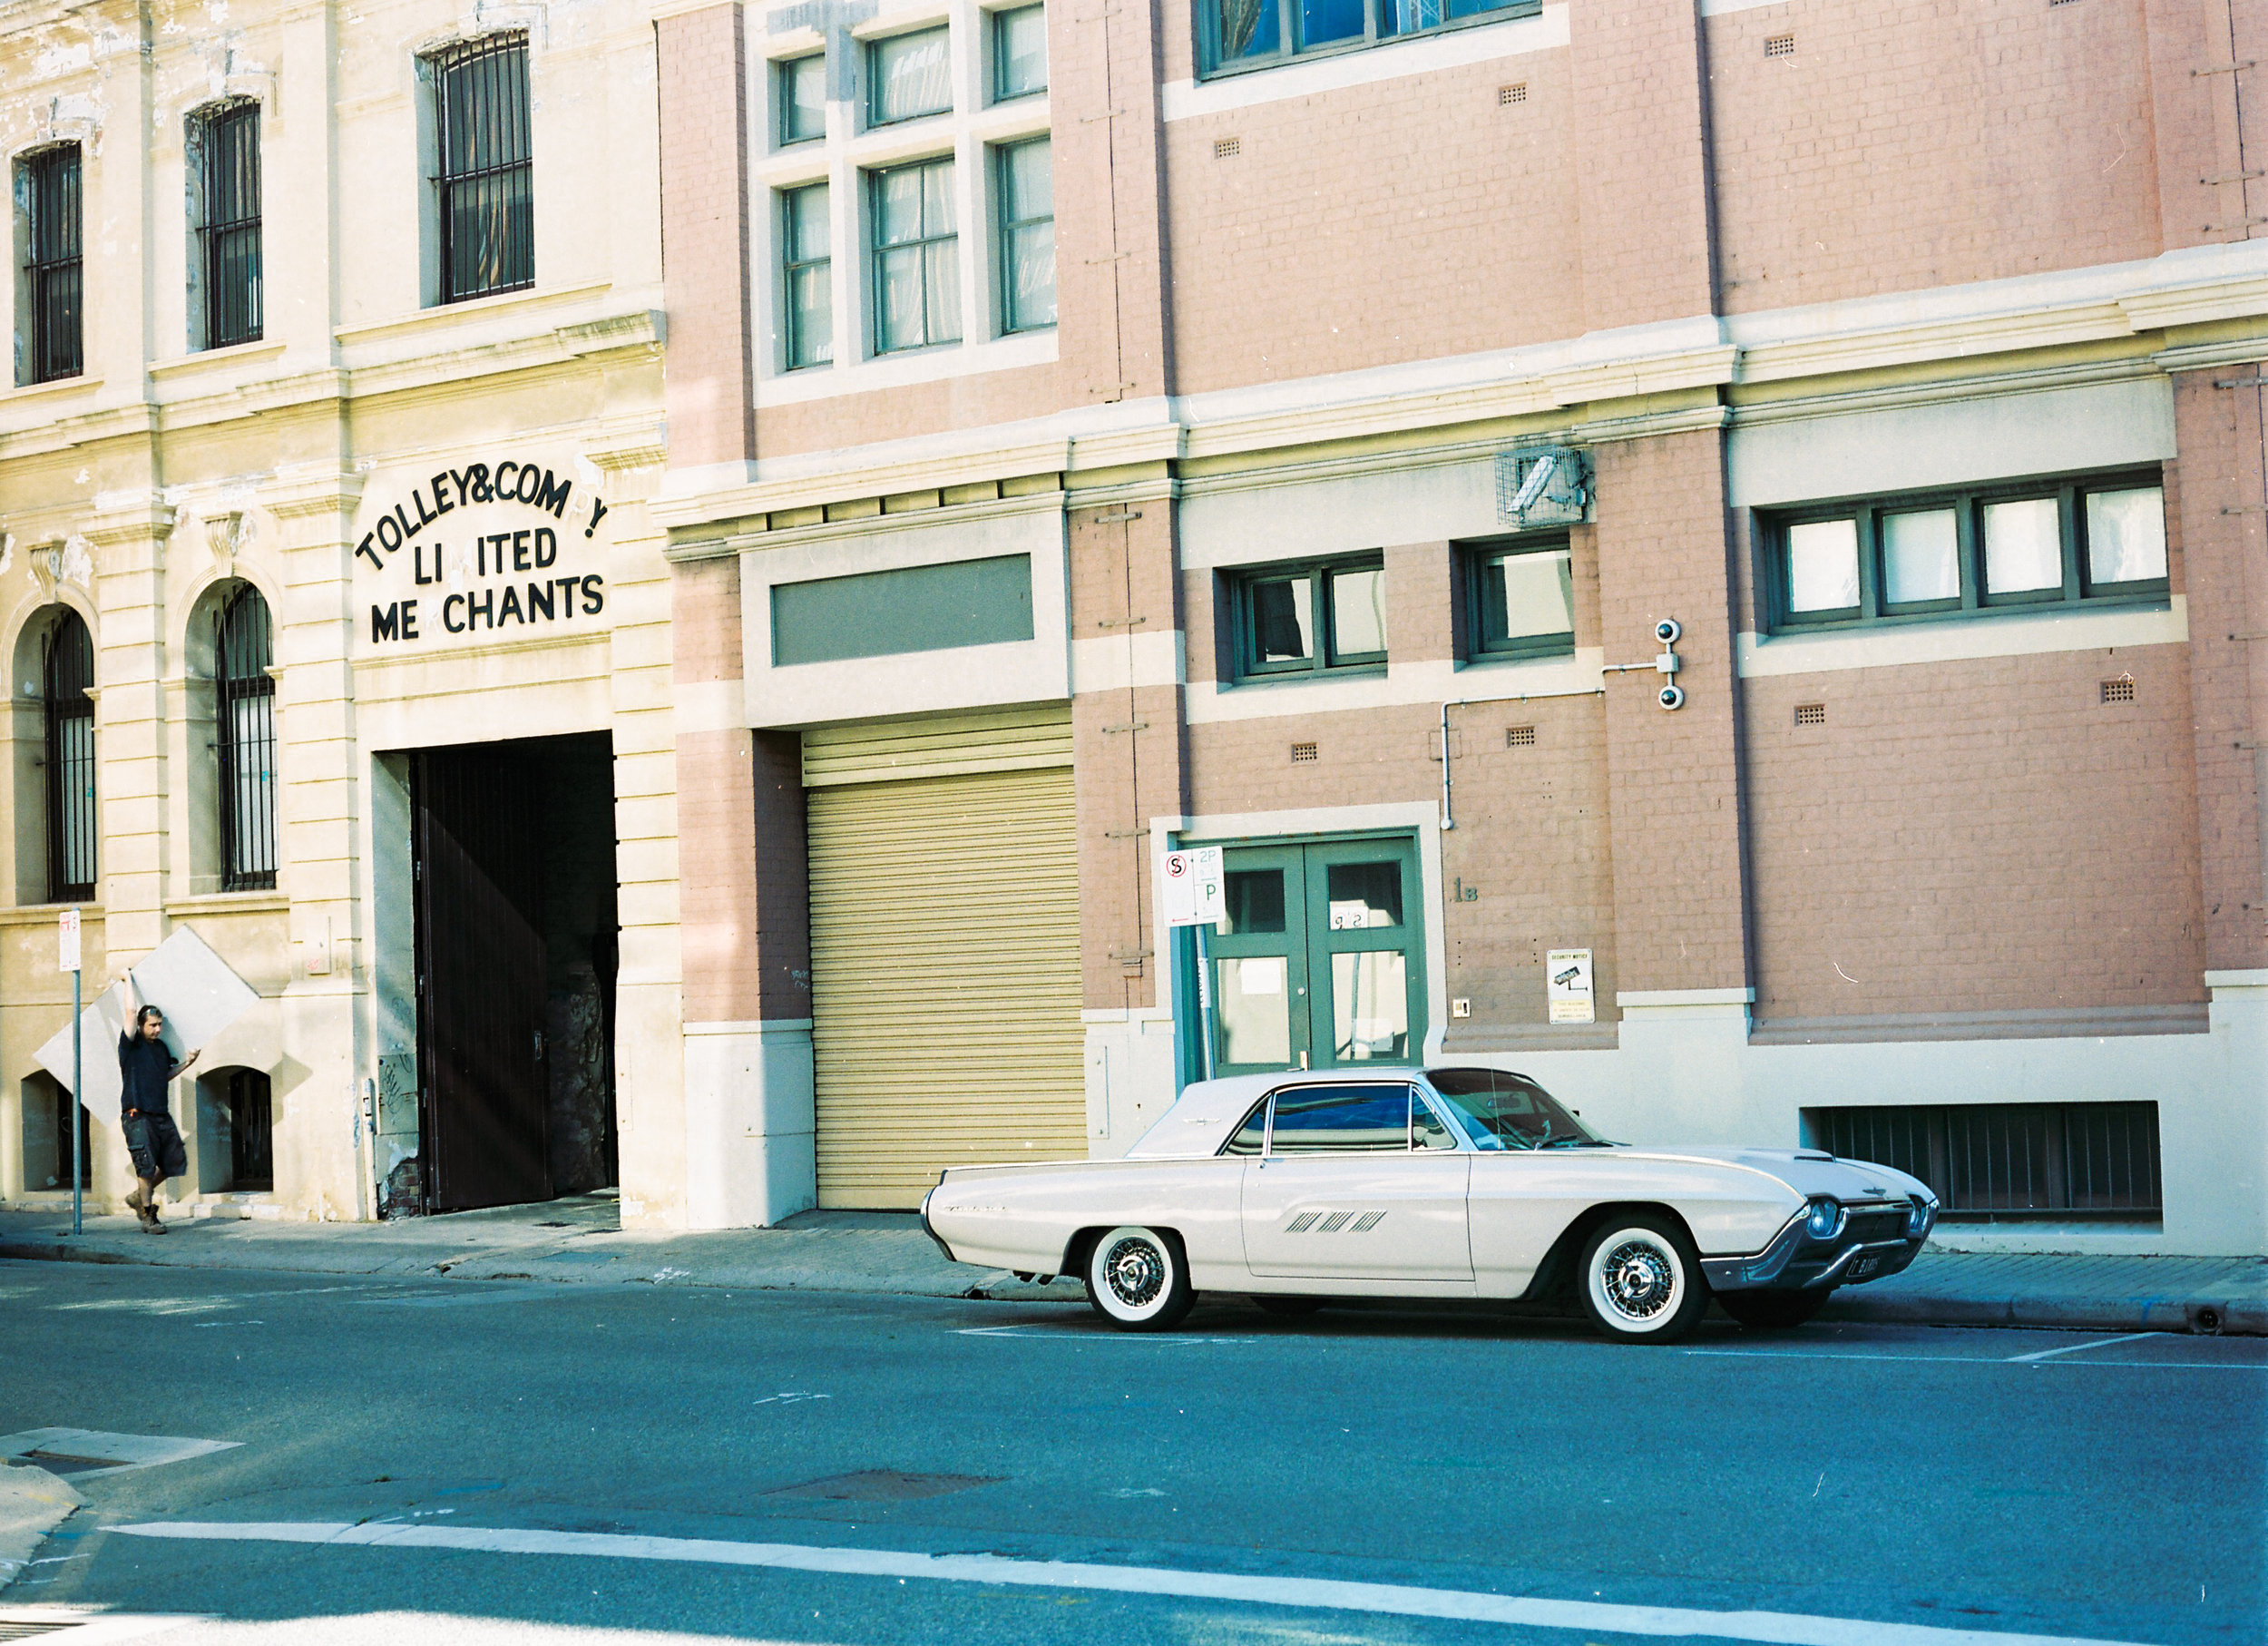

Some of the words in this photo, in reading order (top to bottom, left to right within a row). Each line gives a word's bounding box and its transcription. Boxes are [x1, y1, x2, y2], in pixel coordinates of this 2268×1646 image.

[415, 527, 556, 584] LIITED
[371, 574, 603, 643] MECHANTS
[1199, 849, 1217, 863] 2P
[1171, 857, 1182, 874] S
[1207, 884, 1217, 901] P
